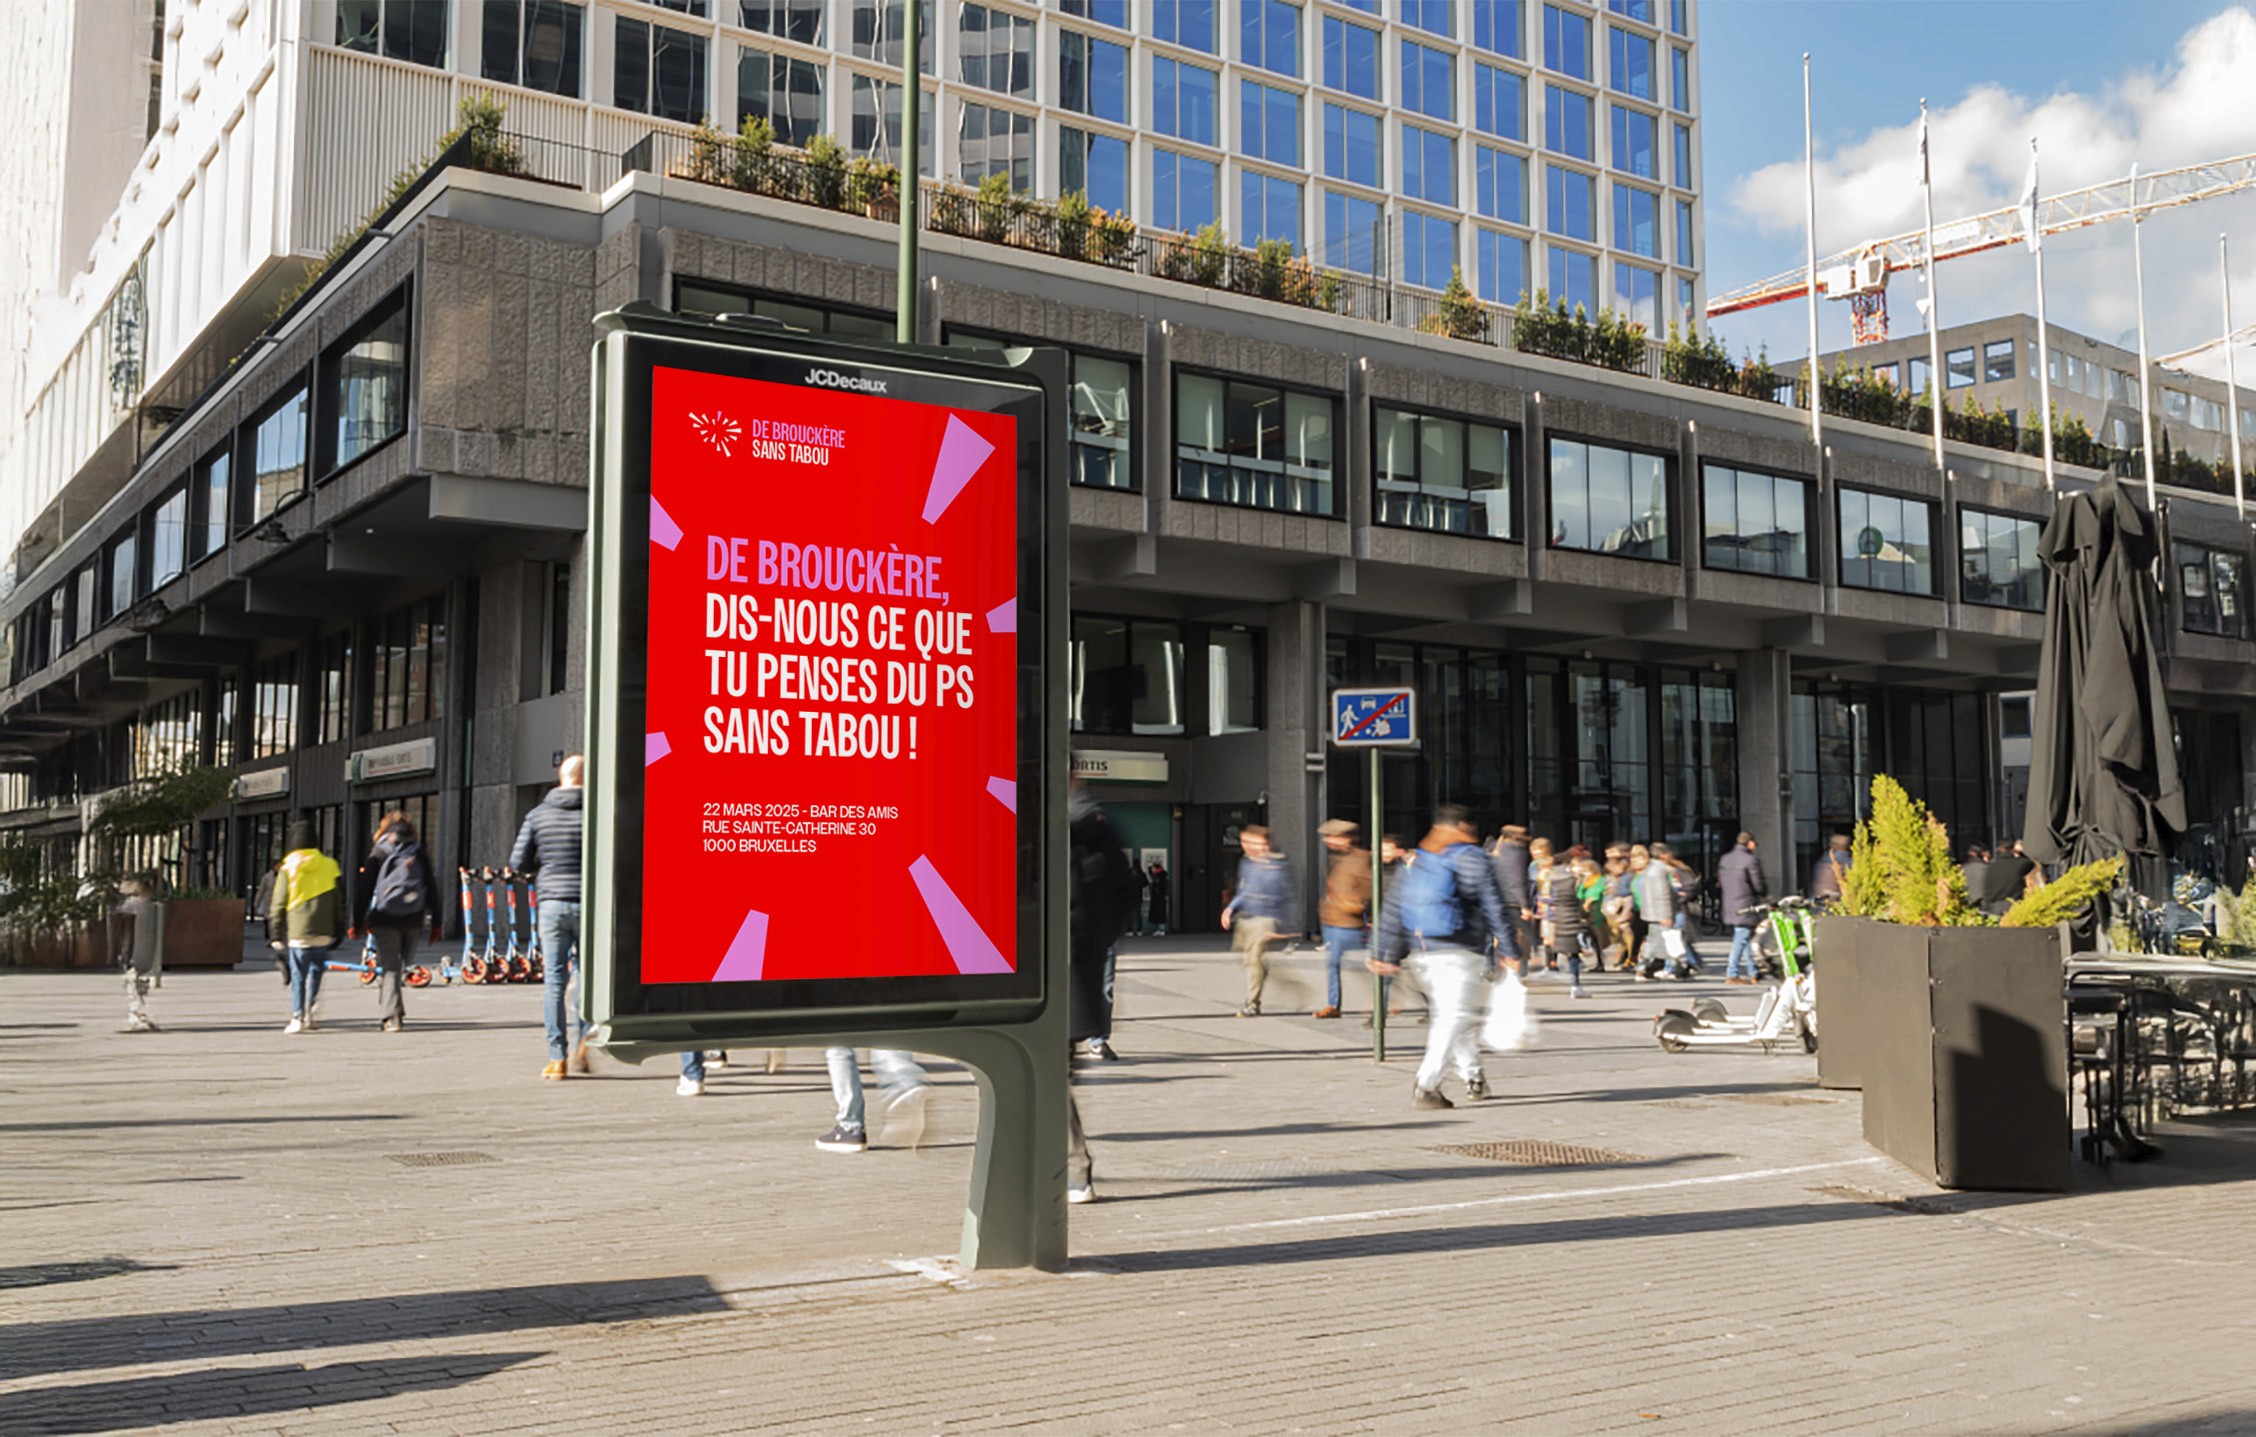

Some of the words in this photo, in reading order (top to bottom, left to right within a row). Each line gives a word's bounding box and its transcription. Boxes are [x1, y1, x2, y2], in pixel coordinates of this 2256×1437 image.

[805, 368, 887, 393] JCDecaux
[752, 418, 769, 439] DE
[772, 421, 846, 449] BROUCKÈRE
[752, 439, 786, 461] SANS
[788, 443, 829, 466] TABOU
[707, 535, 748, 583] DE
[759, 540, 950, 606] BROUCKÈRE,
[706, 592, 859, 648] DIS-NOUS
[868, 605, 906, 651] CE
[915, 609, 973, 661] QUE
[705, 649, 747, 697] TU
[758, 653, 877, 704] PENSES
[887, 661, 926, 706] DU
[937, 664, 975, 709] PS
[704, 706, 789, 756] SANS
[799, 711, 900, 759] TABOU
[910, 716, 917, 759] !
[1070, 760, 1108, 772] ORTIS
[703, 803, 720, 816] 22
[723, 803, 762, 816] MARS
[765, 804, 800, 817] 2025
[810, 805, 837, 818] BAR
[840, 805, 865, 818] DES
[867, 806, 899, 819] AMIS
[703, 820, 730, 833] RUE
[733, 821, 857, 835] SAINTE-CATHERINE
[859, 822, 876, 835] 30
[703, 839, 736, 852] 1000
[739, 839, 817, 852] BRUXELLES
